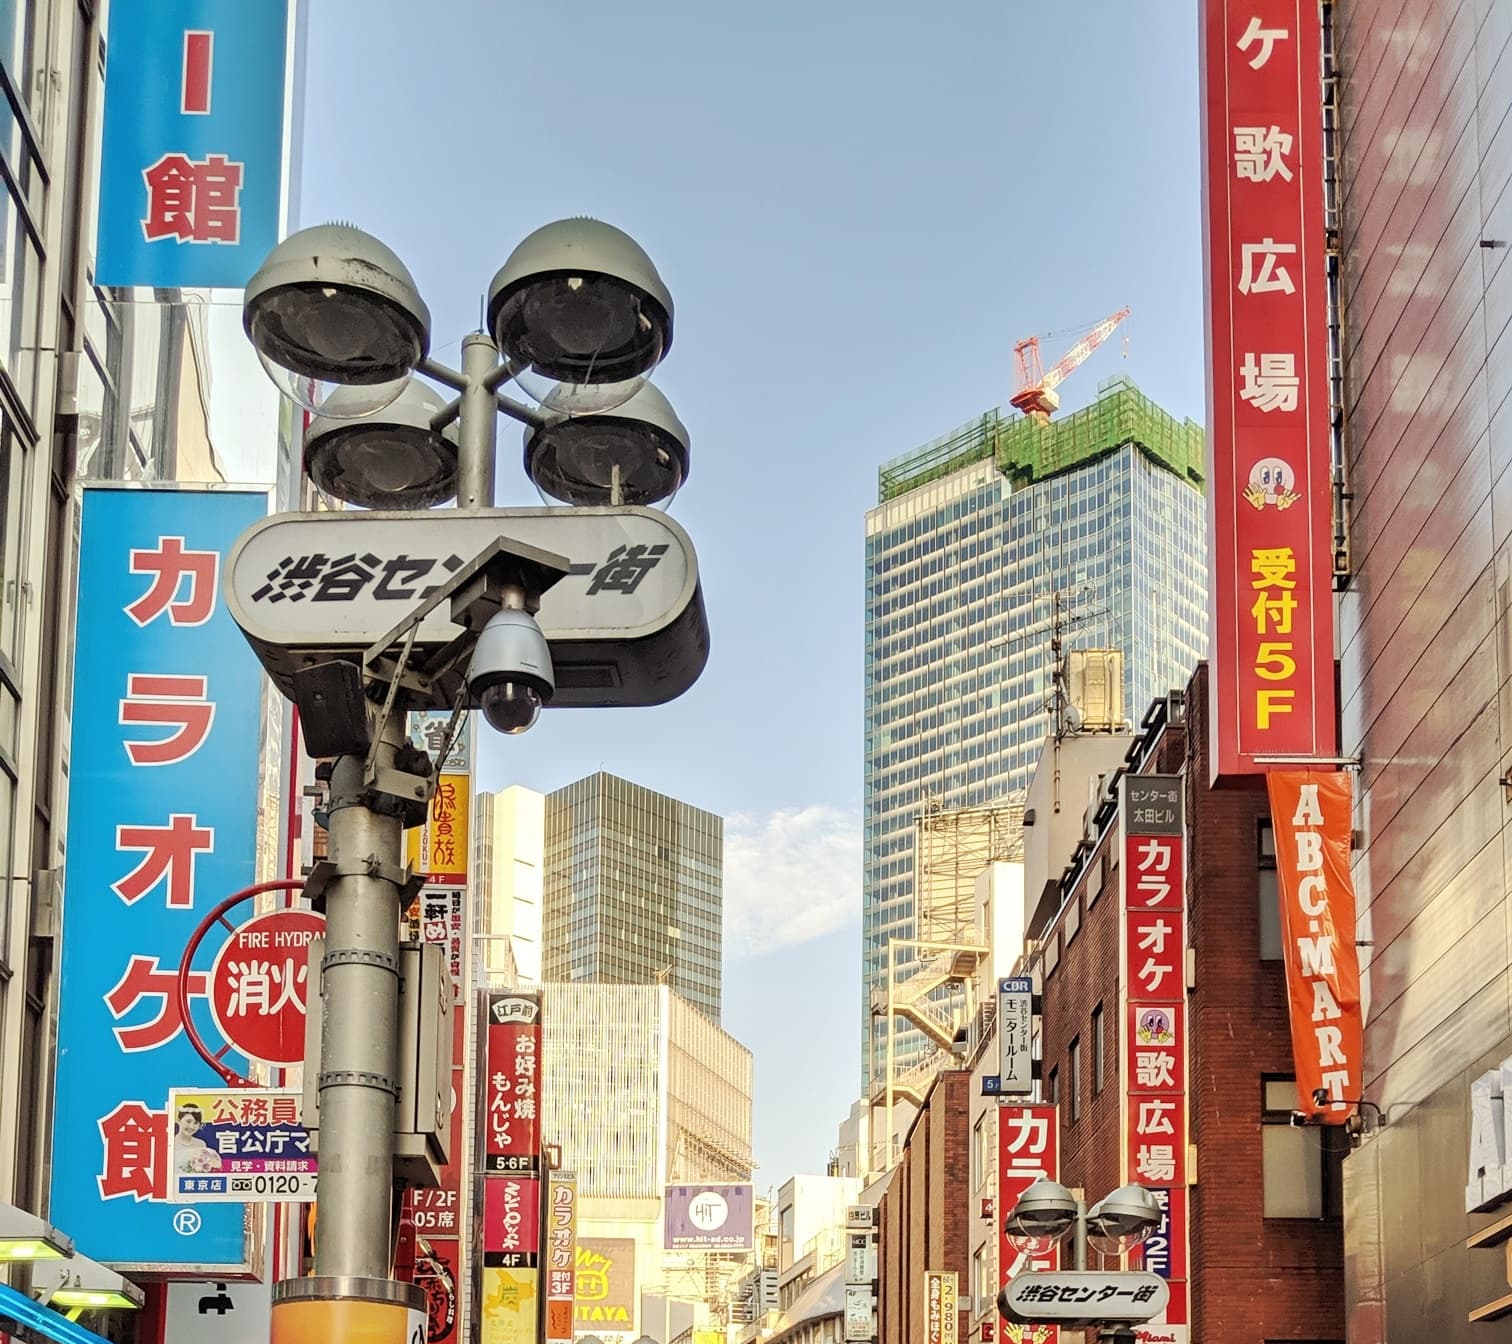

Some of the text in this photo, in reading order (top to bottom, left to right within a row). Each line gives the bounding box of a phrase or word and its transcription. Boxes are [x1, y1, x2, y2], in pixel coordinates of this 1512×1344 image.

[251, 544, 670, 604] 渋谷セー街
[1250, 547, 1298, 730] 受付5F
[1130, 790, 1178, 803] センター街
[1134, 808, 1175, 823] 太田ビル
[428, 875, 446, 883] 4F
[1137, 839, 1172, 993] カラオケ
[239, 931, 326, 949] FIRE HYDRA
[226, 958, 307, 1018] 消火
[1003, 981, 1028, 991] CBR
[497, 1003, 533, 1018] 江戸前
[1006, 999, 1018, 1081] モニタールーム
[514, 1034, 536, 1120] お好み焼
[490, 1071, 512, 1149] もんじゃ
[1135, 1050, 1177, 1182] 歌広場
[215, 1130, 311, 1155] 官公庁マ
[231, 1158, 309, 1172] 見学・資料請求
[183, 1179, 222, 1191] 東京店
[551, 1185, 573, 1268] カラオケ
[502, 1254, 520, 1267] 4F
[551, 1271, 571, 1281] 受付
[551, 1282, 571, 1294] 3F
[1016, 1285, 1159, 1303] 渋谷センター街
[1135, 1330, 1177, 1343] Miami
